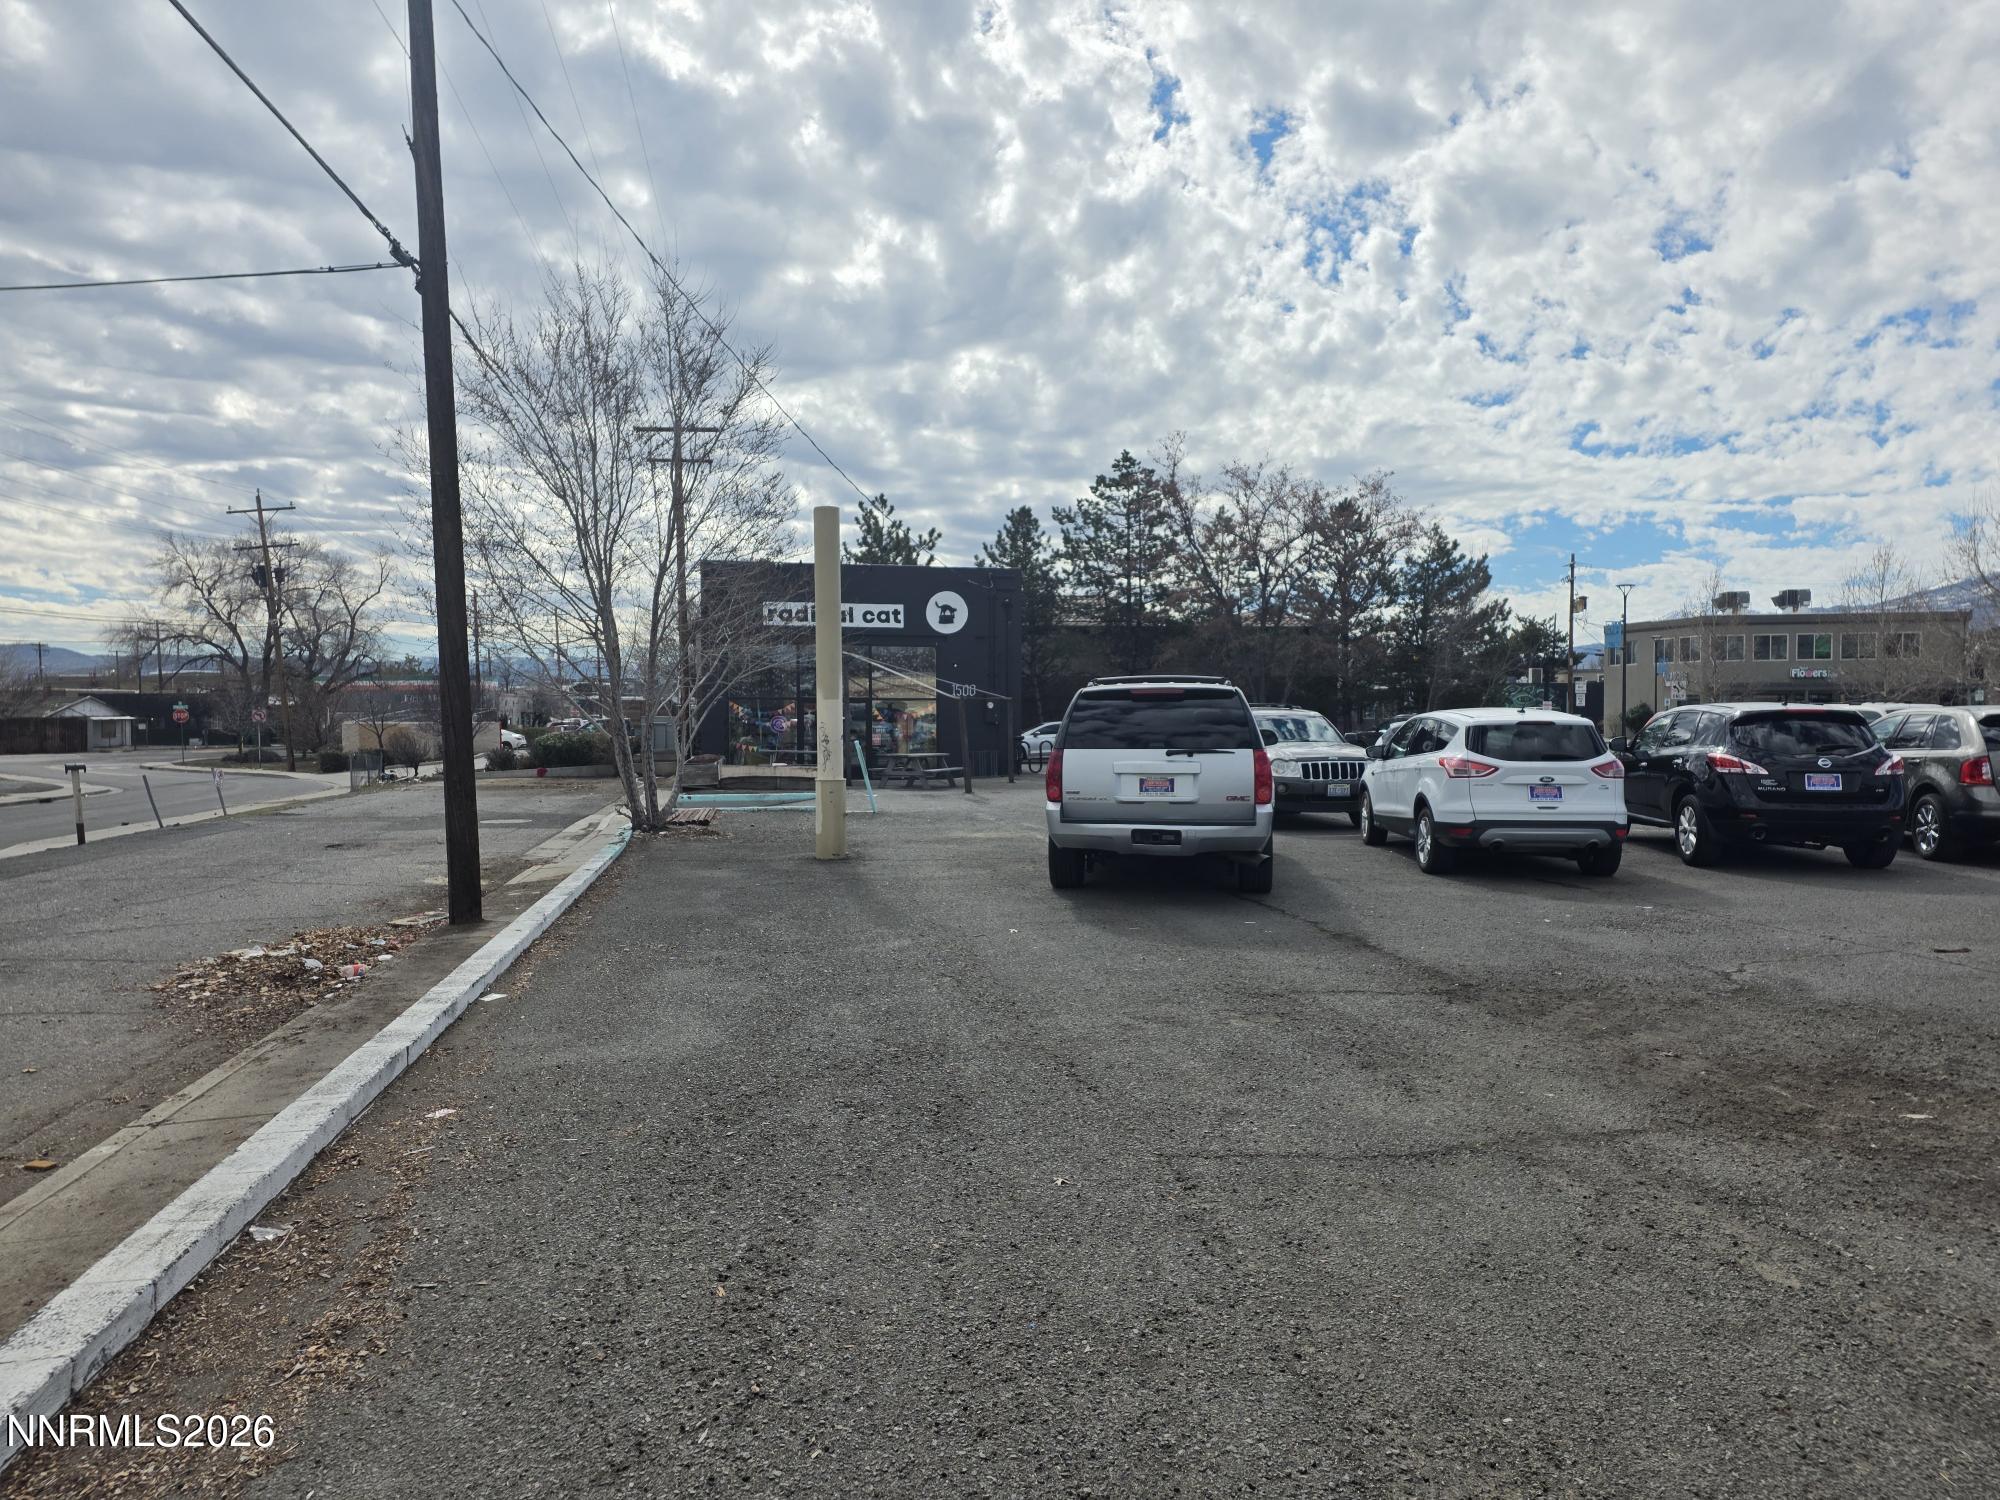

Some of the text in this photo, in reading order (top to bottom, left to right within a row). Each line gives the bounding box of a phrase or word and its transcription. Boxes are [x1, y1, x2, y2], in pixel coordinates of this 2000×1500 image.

[767, 604, 901, 624] radil cat
[952, 684, 976, 697] 1500
